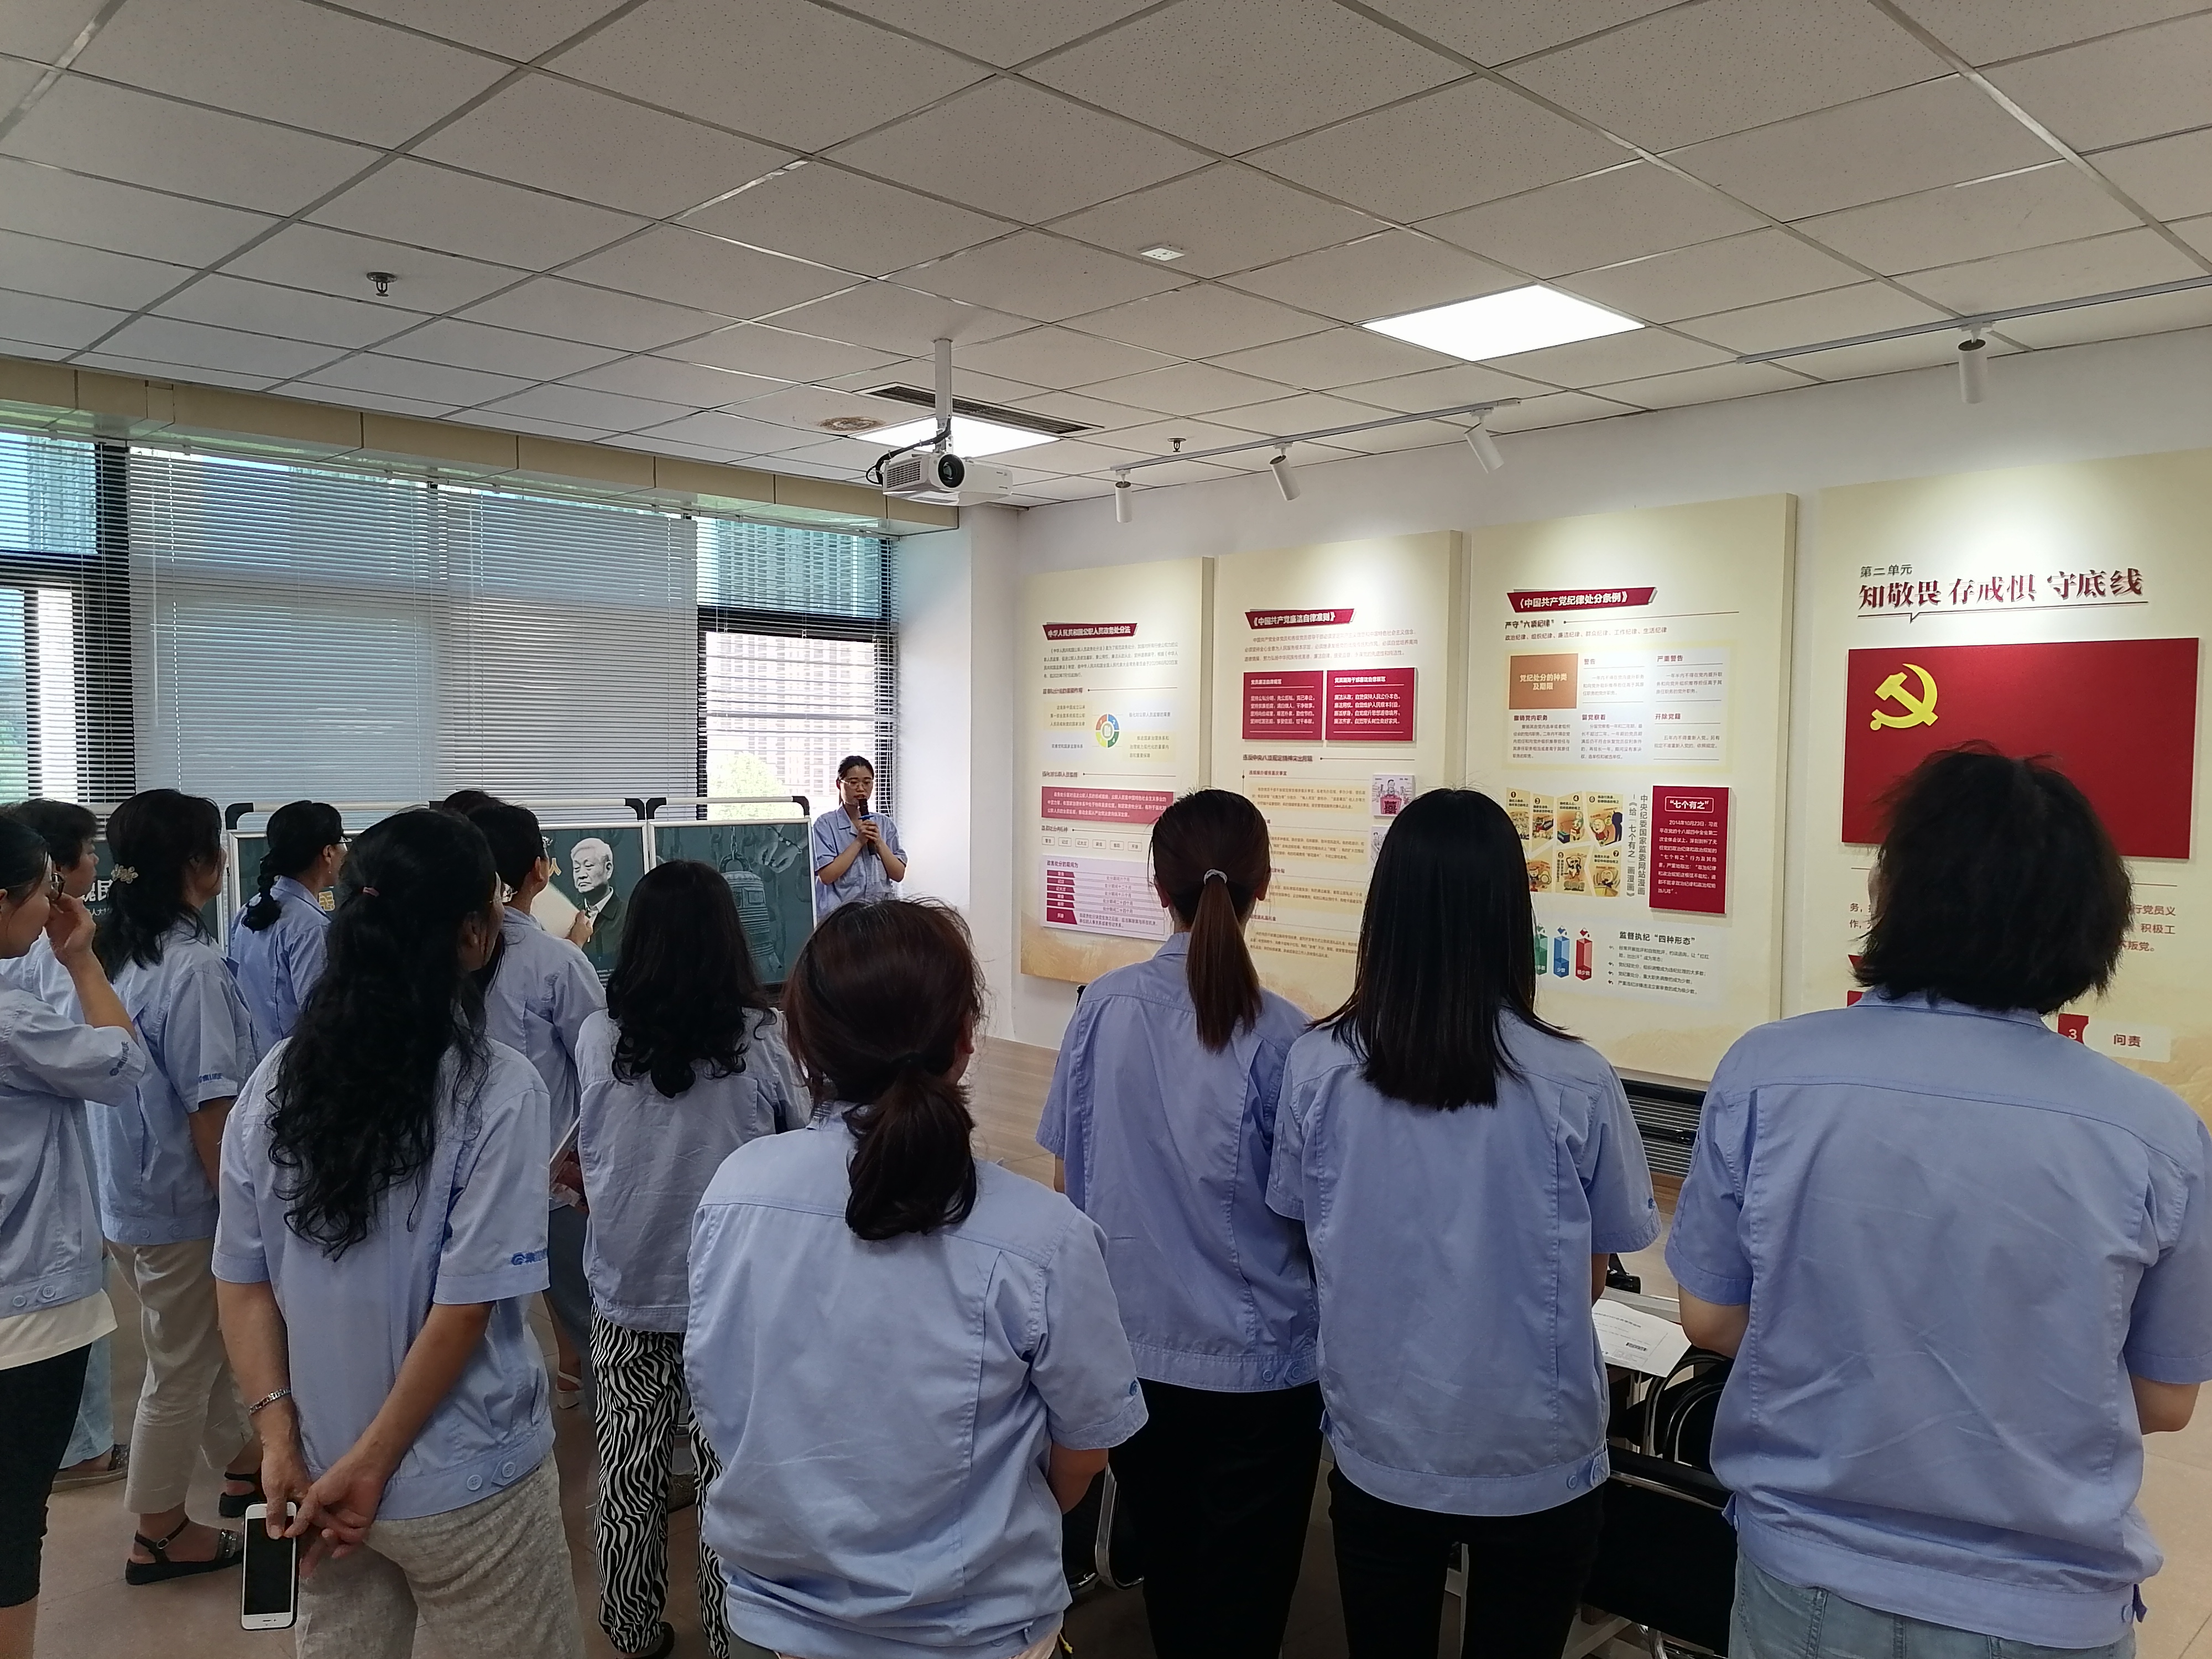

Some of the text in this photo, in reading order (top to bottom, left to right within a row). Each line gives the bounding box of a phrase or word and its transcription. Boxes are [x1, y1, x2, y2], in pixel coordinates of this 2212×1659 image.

[1860, 564, 1913, 578] 第二单元
[1859, 567, 2143, 609] 知敬畏 存戒惧 守底线
[1520, 591, 1627, 609] 《中国共产党纪律处分条例》
[1519, 672, 1568, 682] 党纪处分的种类
[1670, 800, 1709, 810] “七个有之”
[1637, 794, 1648, 895] 中央纪委国家监委网站漫画
[2141, 923, 2176, 935] 积极工
[2068, 1029, 2077, 1040] 3
[2113, 1034, 2141, 1047] 问责
